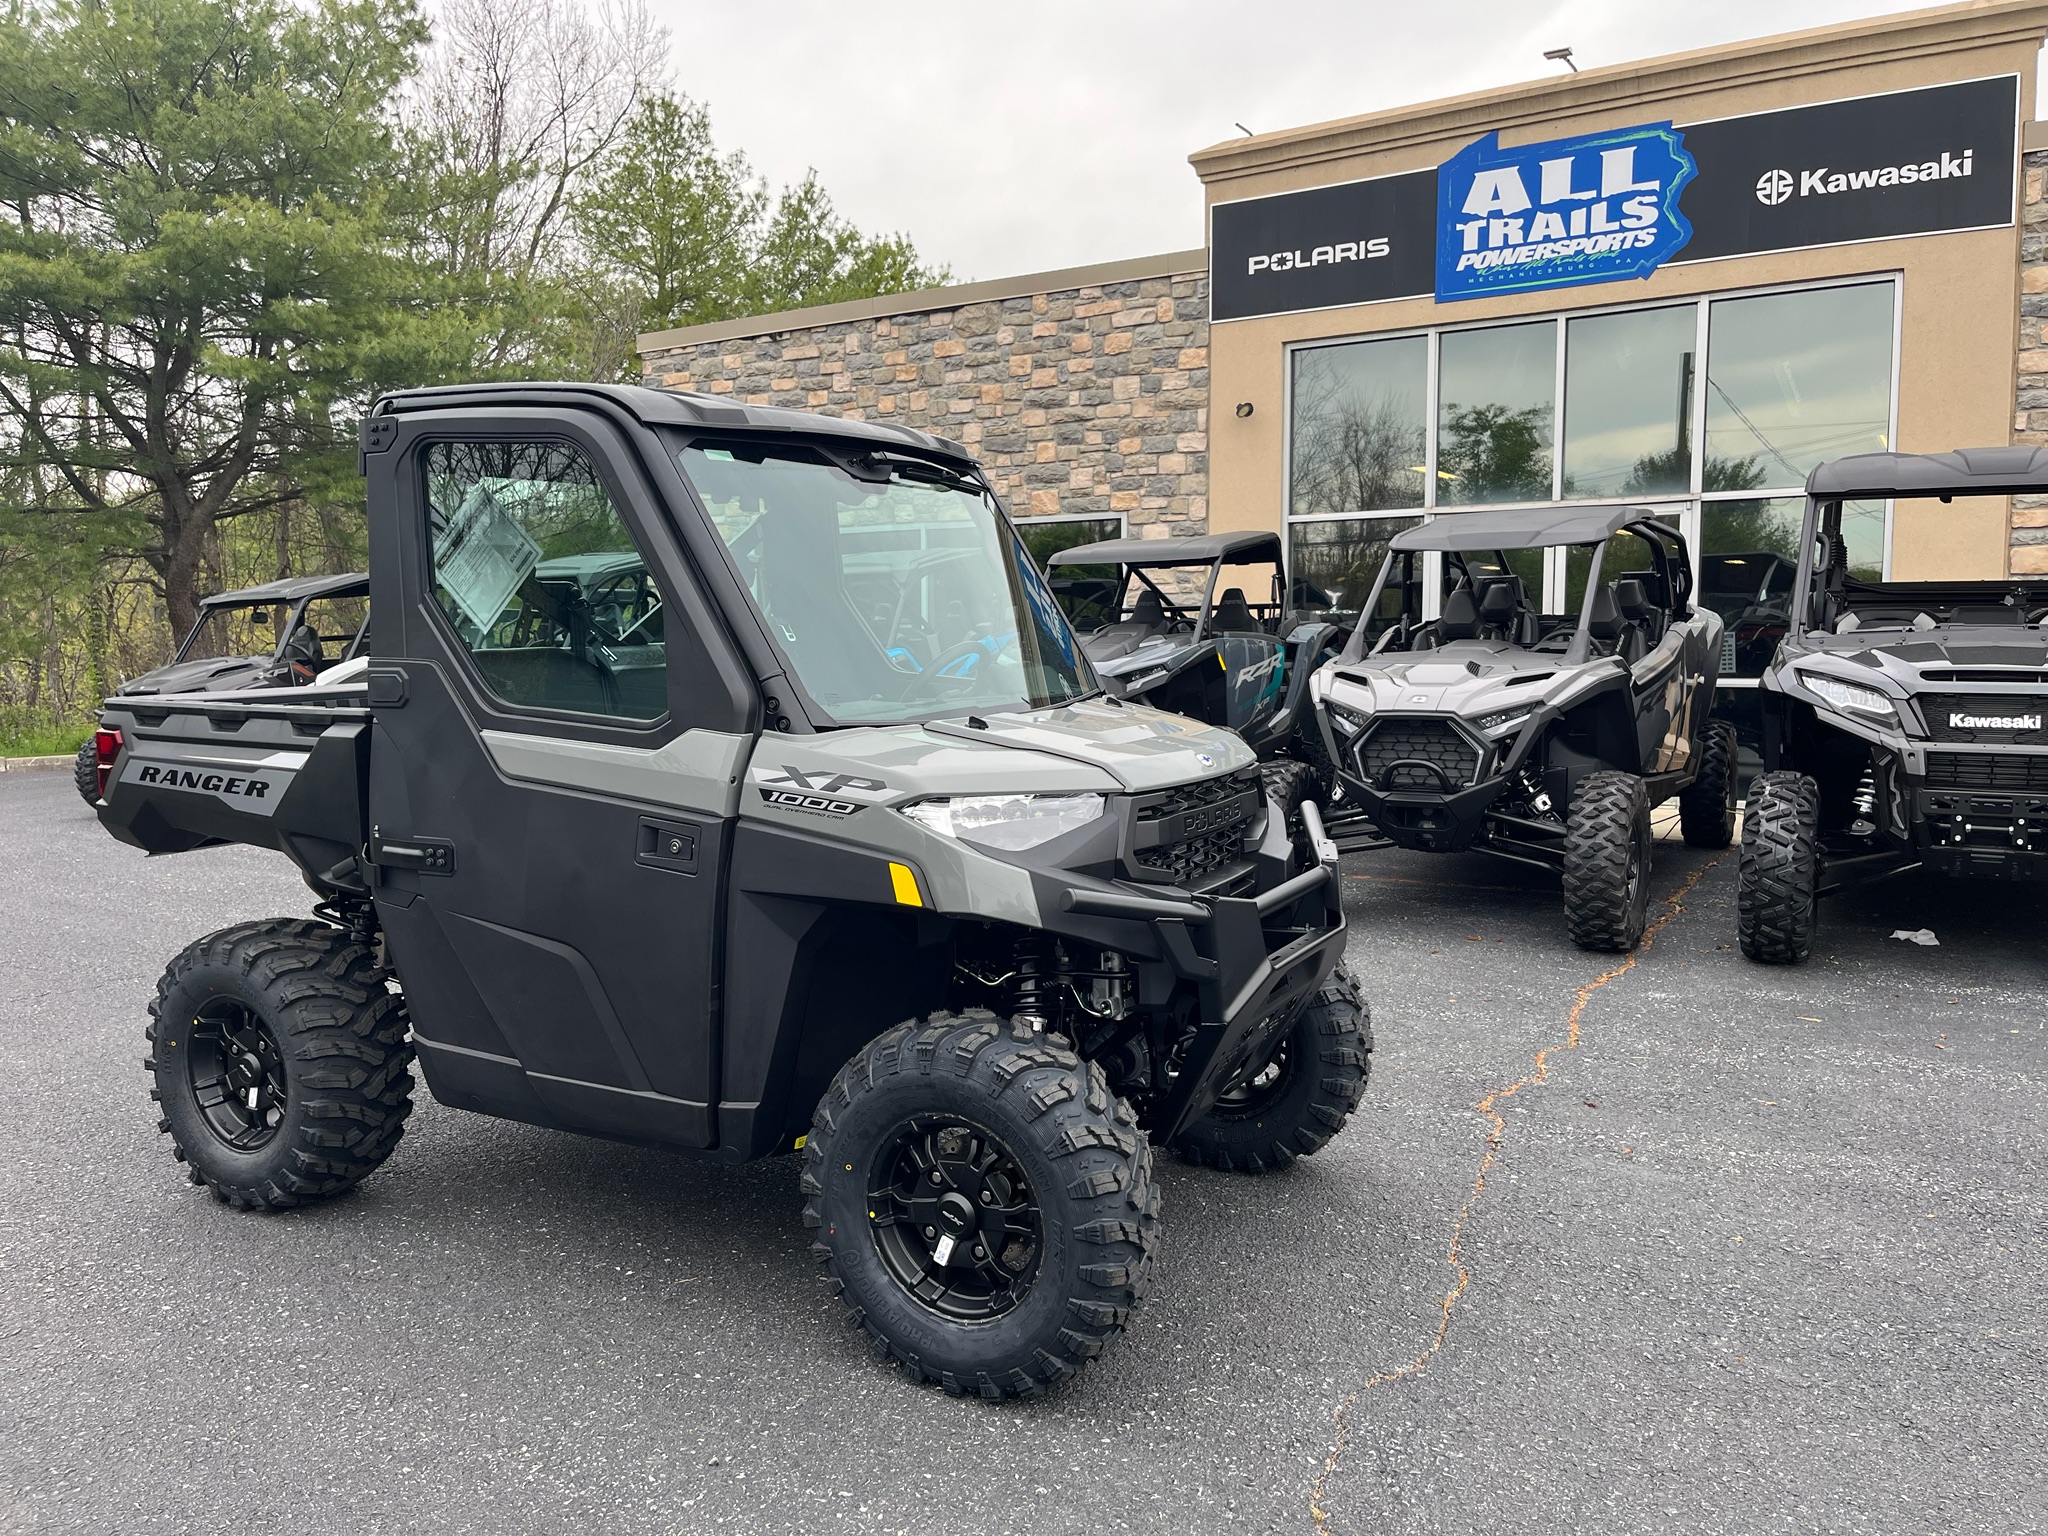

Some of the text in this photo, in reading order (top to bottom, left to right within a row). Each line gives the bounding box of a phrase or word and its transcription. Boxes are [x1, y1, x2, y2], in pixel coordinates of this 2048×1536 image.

[1461, 146, 1660, 217] ALL
[1800, 149, 1973, 197] Kawasaki
[1456, 195, 1660, 251] TRAILS
[1248, 237, 1391, 275] POLARIS
[1455, 228, 1658, 272] POWERSPORTS
[1615, 257, 1632, 266] PA
[1235, 651, 1283, 690] RZR
[1255, 695, 1271, 713] XP
[1949, 713, 2042, 729] Kawasaki
[138, 766, 270, 798] RANGER
[759, 764, 888, 793] XP
[763, 804, 783, 812] DUAL
[784, 807, 826, 818] OVERHEAD
[768, 791, 856, 815] 1000
[1184, 803, 1242, 836] POLARIS
